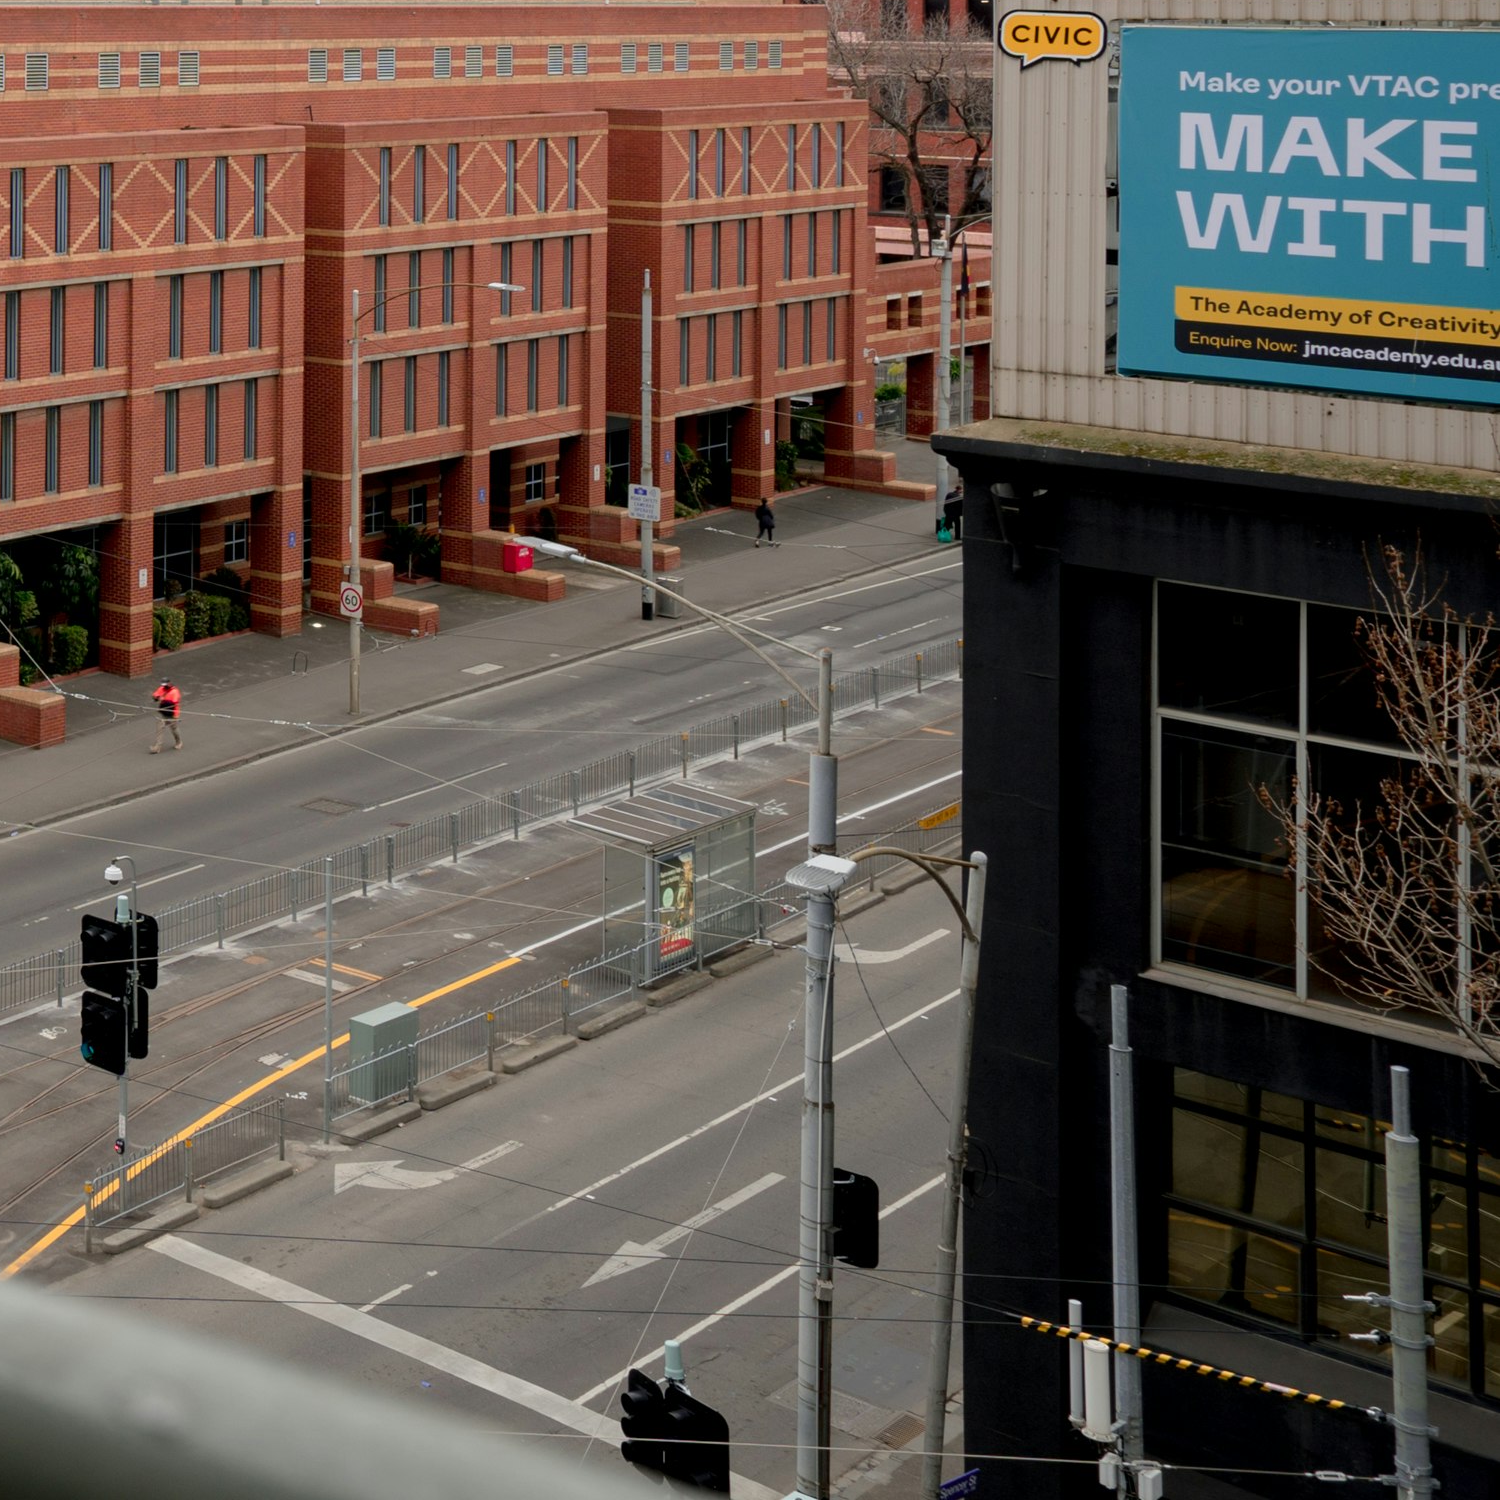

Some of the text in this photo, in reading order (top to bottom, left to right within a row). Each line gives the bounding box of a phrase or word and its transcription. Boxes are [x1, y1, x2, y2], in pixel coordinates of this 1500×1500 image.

[1011, 24, 1093, 46] CIVIC
[1179, 71, 1261, 93] Make
[1267, 77, 1341, 100] your
[1347, 75, 1440, 98] VTAC
[1179, 112, 1478, 183] MAKE
[1175, 190, 1485, 268] WITH
[1190, 295, 1500, 340] The Academy of Creativity
[1189, 331, 1253, 349] Enquire
[1256, 337, 1298, 353] Now:
[344, 594, 358, 607] 60
